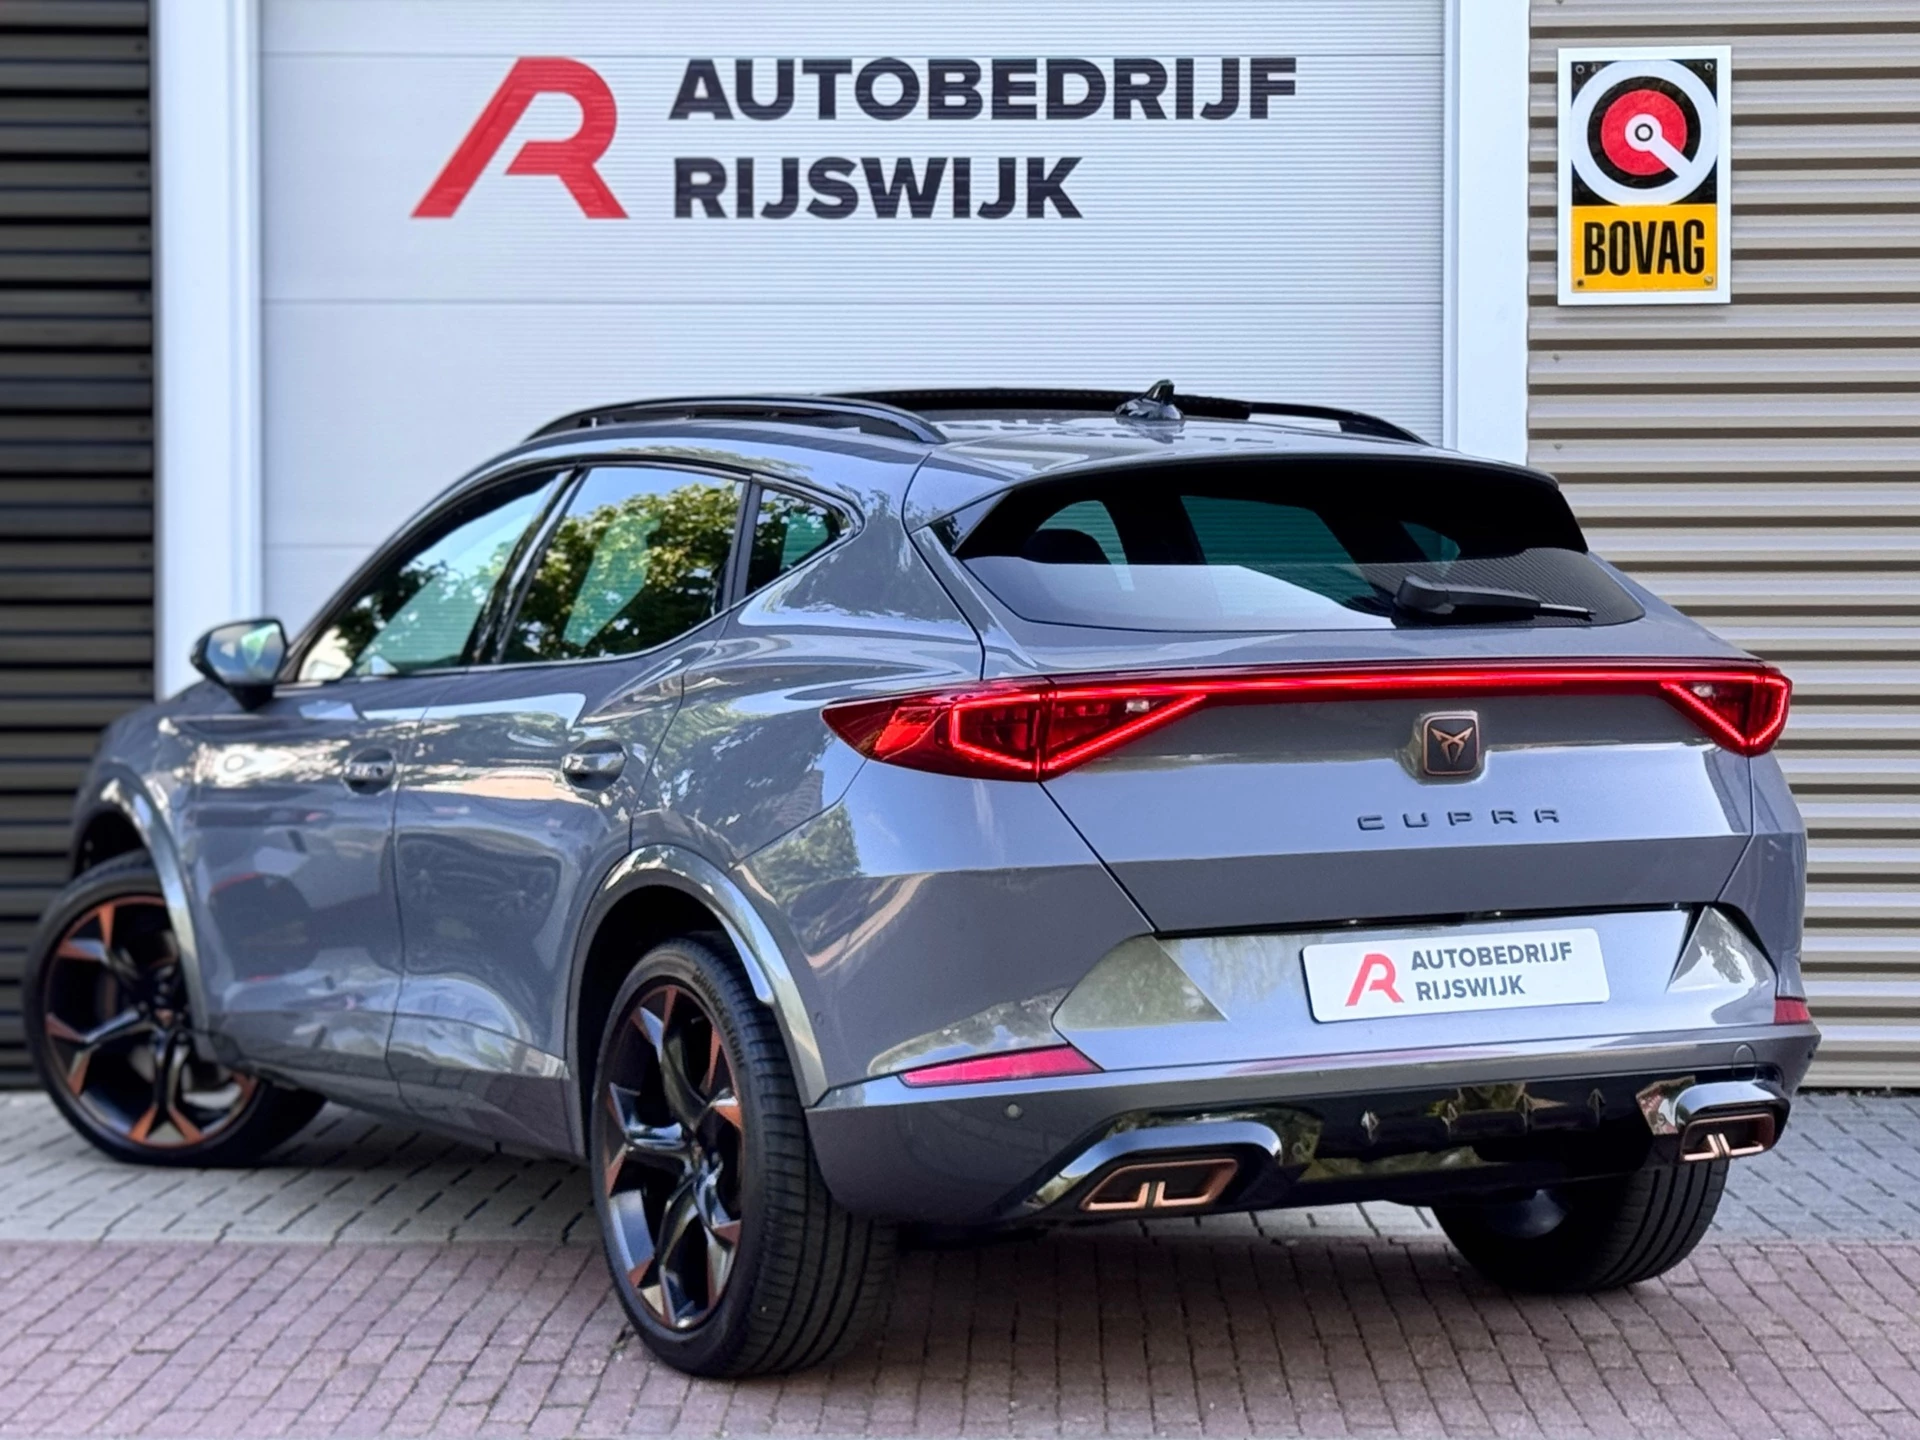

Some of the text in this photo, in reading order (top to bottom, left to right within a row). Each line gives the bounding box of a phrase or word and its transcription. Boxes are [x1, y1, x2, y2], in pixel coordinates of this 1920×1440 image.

[669, 57, 1297, 120] AUTOBEDRIJF
[674, 157, 1083, 219] RIJSWIJK
[1583, 219, 1705, 276] BOVAG
[1357, 808, 1559, 831] CUPRA
[1411, 941, 1572, 971] AUTOBEDRIJF
[1415, 975, 1526, 1001] RIJSWIJK
